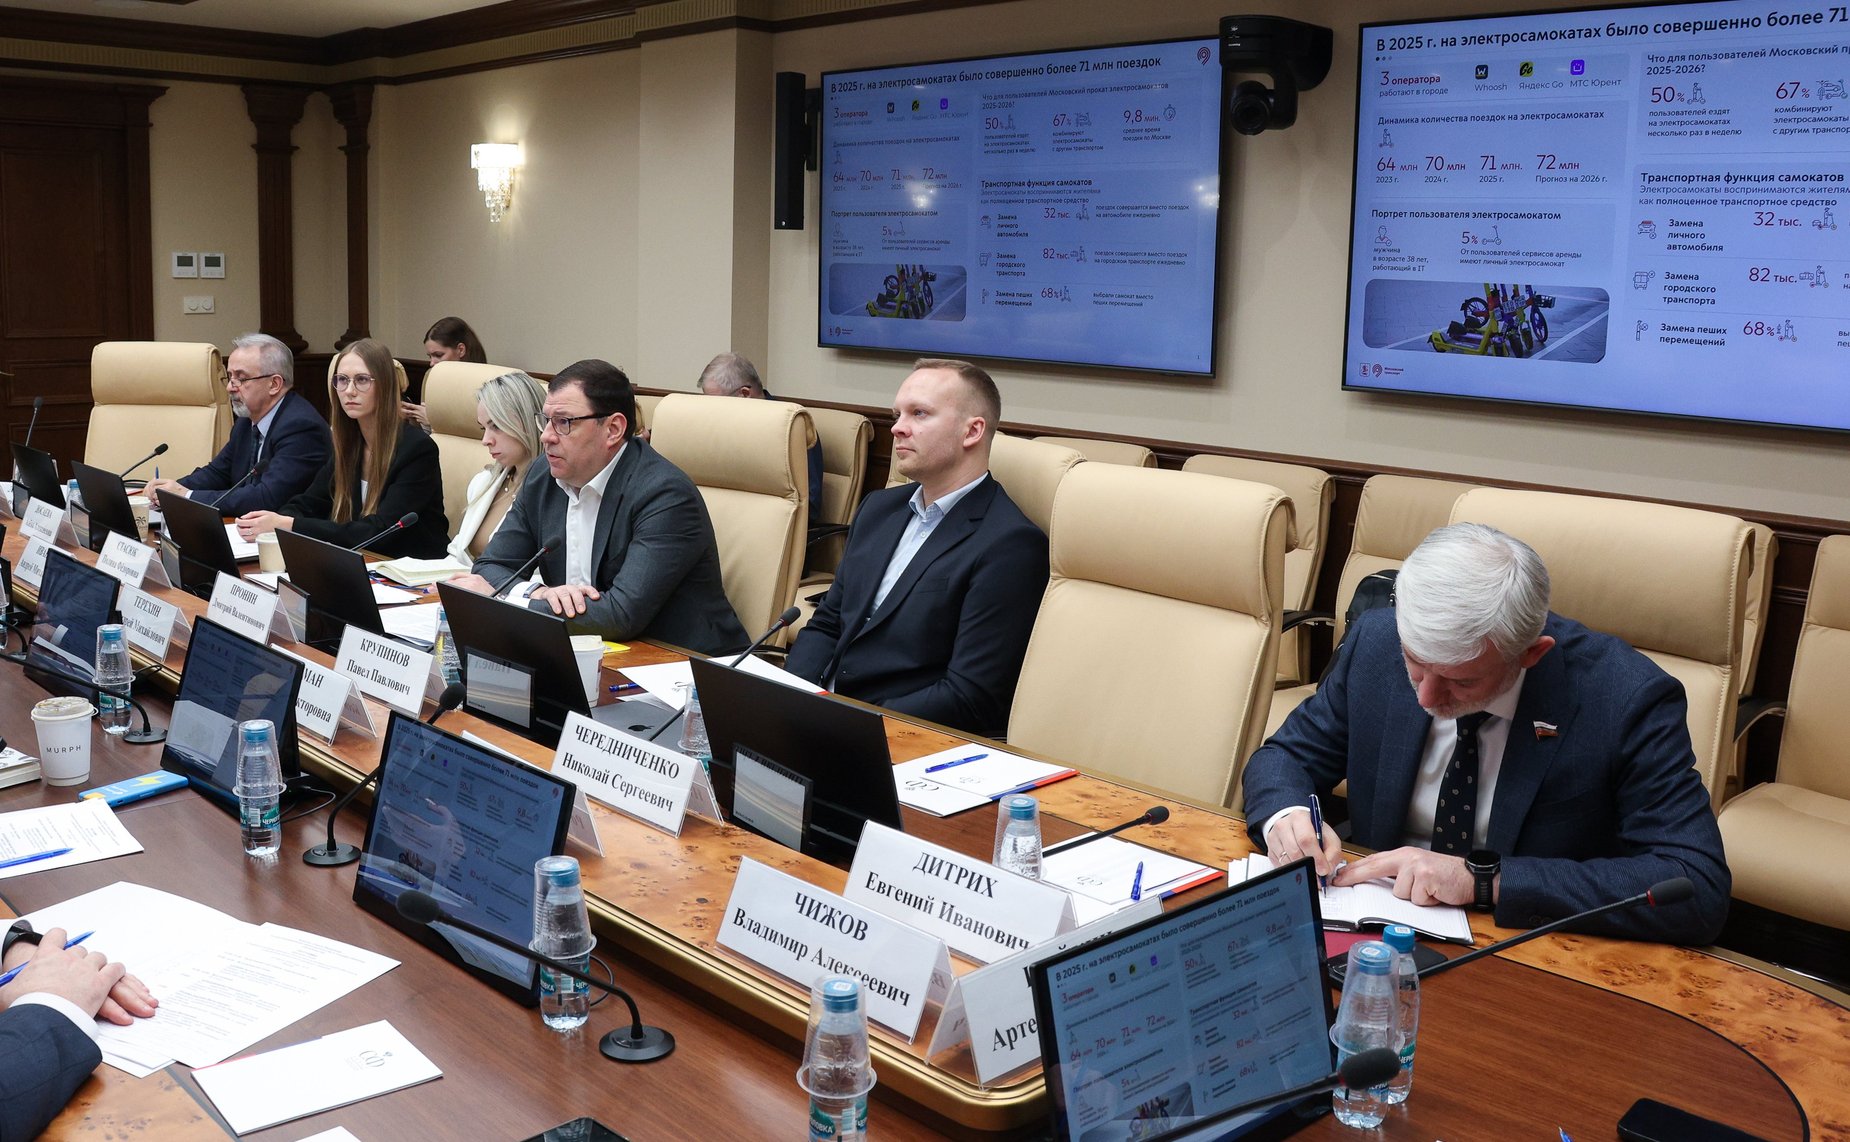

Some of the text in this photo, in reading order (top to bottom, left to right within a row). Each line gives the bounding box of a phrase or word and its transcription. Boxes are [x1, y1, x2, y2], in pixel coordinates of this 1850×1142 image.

[1376, 7, 1849, 51] В 2025 г. на электросамокатах было совершенно более 71
[1648, 54, 1665, 63] Что
[1667, 54, 1686, 64] для
[1688, 48, 1767, 62] пользователей
[1769, 45, 1838, 58] Московский
[838, 56, 1162, 92] 2025 на электросамокатах было совершенно более 71 млн поездок
[1646, 64, 1706, 76] 2025-2026?
[1380, 71, 1441, 86] 3 оператора
[1570, 78, 1622, 88] МТС Юрент
[1049, 86, 1086, 97] Московский
[1086, 85, 1108, 96] прокат
[1474, 83, 1508, 92] Whoosh
[1519, 80, 1564, 91] Яндекс Go
[1379, 87, 1449, 98] работают городе
[1648, 108, 1730, 118] пользователей ездят
[1774, 105, 1833, 116] комбинируют
[1123, 110, 1143, 125] 9,8
[1378, 115, 1420, 126] Динамика
[1421, 113, 1468, 124] количества
[1470, 113, 1506, 122] поездок
[1520, 111, 1605, 122] электросамокатах
[1658, 118, 1731, 129] электросамокатах
[1648, 130, 1688, 138] несколько
[1712, 128, 1742, 137] неделю
[1780, 127, 1810, 138] другим
[1376, 156, 1418, 172] 64 млн
[1425, 156, 1466, 172] 70 млн
[1480, 155, 1497, 171] 71
[1536, 154, 1580, 170] 72 млн
[833, 171, 844, 182] 64
[860, 170, 872, 182] 70
[890, 170, 900, 181] 71
[922, 168, 934, 180] 72
[1376, 176, 1393, 184] 2023
[1424, 175, 1442, 184] 2024
[1479, 175, 1498, 183] 2025
[1536, 175, 1568, 184] Прогноз
[1580, 175, 1600, 183] 2026
[1640, 172, 1844, 184] Транспортная функция самокатов
[981, 179, 1092, 190] Транспортная функция самокатов
[1640, 185, 1722, 196] Электросамокаты
[1724, 186, 1806, 196] воспринимаются
[1638, 198, 1838, 208] как полноценное транспортное средство
[1044, 208, 1056, 219] 32
[1371, 210, 1562, 221] Портрет пользователя электросамокатом
[1753, 212, 1802, 227] 32 тыс.
[1668, 218, 1704, 228] Замена
[1668, 232, 1706, 240] личного
[1666, 242, 1724, 252] автомобиля
[1042, 248, 1070, 260] 82 тыс.
[1470, 249, 1582, 260] пользователей сервисов аренды
[1509, 259, 1564, 268] электросамокат
[1664, 271, 1700, 282] Замена
[1748, 267, 1798, 284] 82 тыс.
[1663, 284, 1716, 295] городского
[1662, 296, 1716, 306] транспорта
[1660, 323, 1728, 336] Замена пеших
[1659, 336, 1726, 347] перемещений
[230, 584, 258, 605] ПРОНИН
[134, 596, 162, 618] ТЕРЕХИН
[212, 597, 266, 631] Дмитрий Валентинович
[122, 616, 166, 646] рей Михайлович
[360, 638, 410, 668] КРУПИНОВ
[303, 667, 325, 689] МАН
[346, 658, 410, 696] Павел Павлович
[296, 697, 332, 723] кторовна
[46, 745, 81, 754] MURPH
[576, 724, 680, 780] ЧЕРЕДНИЧЕНКО
[562, 752, 674, 813] Николай Сергеевич
[912, 852, 999, 899] ДИТРИХ
[864, 871, 934, 914] Евгений
[936, 900, 1030, 950] Иванович
[794, 892, 868, 942] ЧИЖОВ
[732, 907, 809, 962] Владимир
[1063, 964, 1081, 980] 2025
[1098, 936, 1160, 964] электросамокатах
[1161, 927, 1178, 940] было
[1217, 904, 1236, 916] более
[1256, 886, 1280, 901] поездок
[992, 1017, 1038, 1052] Арте
